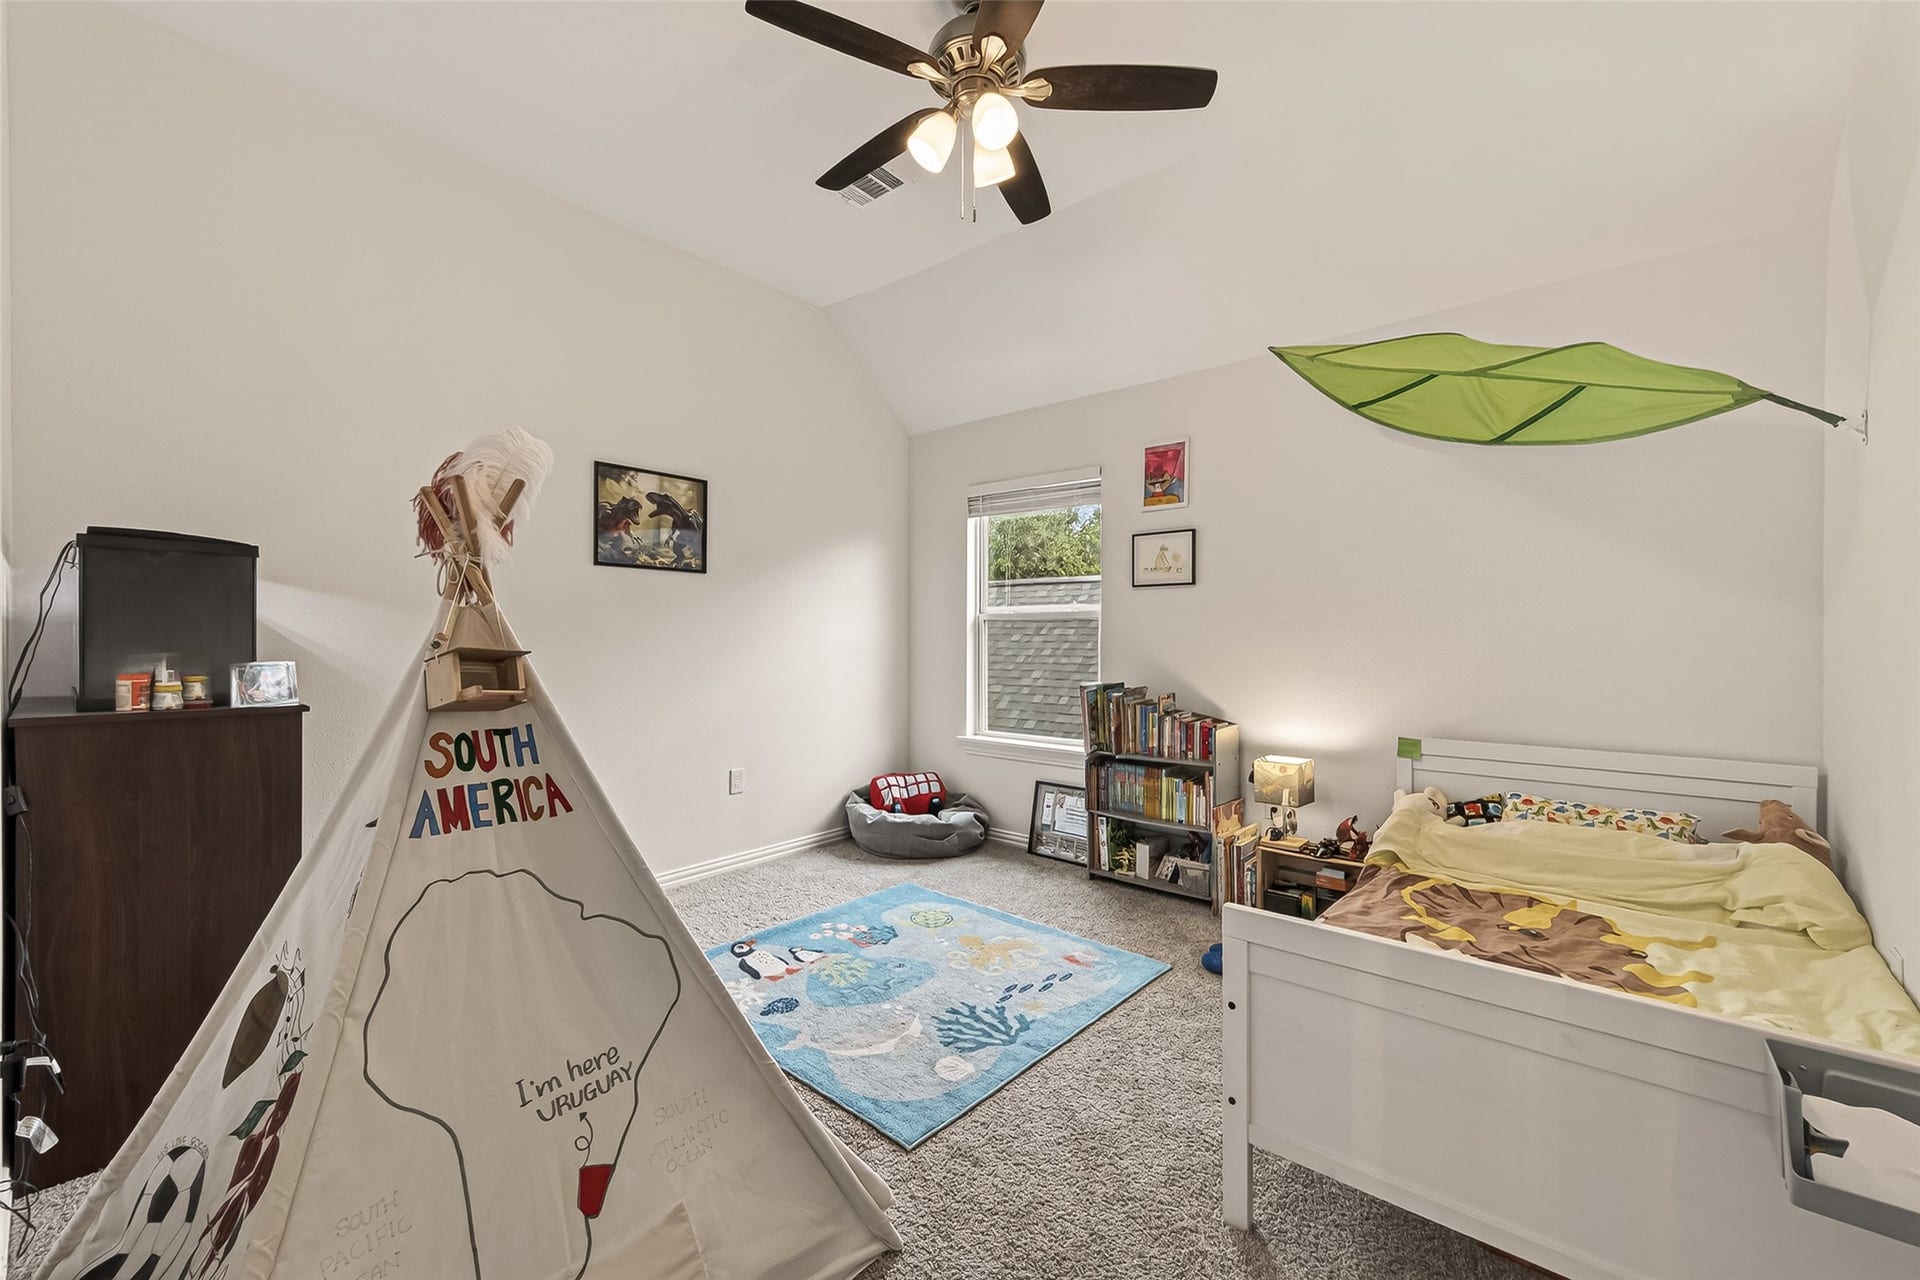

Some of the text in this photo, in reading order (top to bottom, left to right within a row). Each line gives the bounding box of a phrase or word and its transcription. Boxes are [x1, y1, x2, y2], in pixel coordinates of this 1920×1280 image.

[424, 723, 540, 778] SOUTH
[408, 772, 574, 839] AMERICA
[515, 1046, 620, 1108] I'm here
[536, 1061, 633, 1122] URUGUAY
[653, 1088, 708, 1126] SOUTH
[335, 1188, 400, 1238] SOUTH
[320, 1212, 413, 1280] PACIFIC
